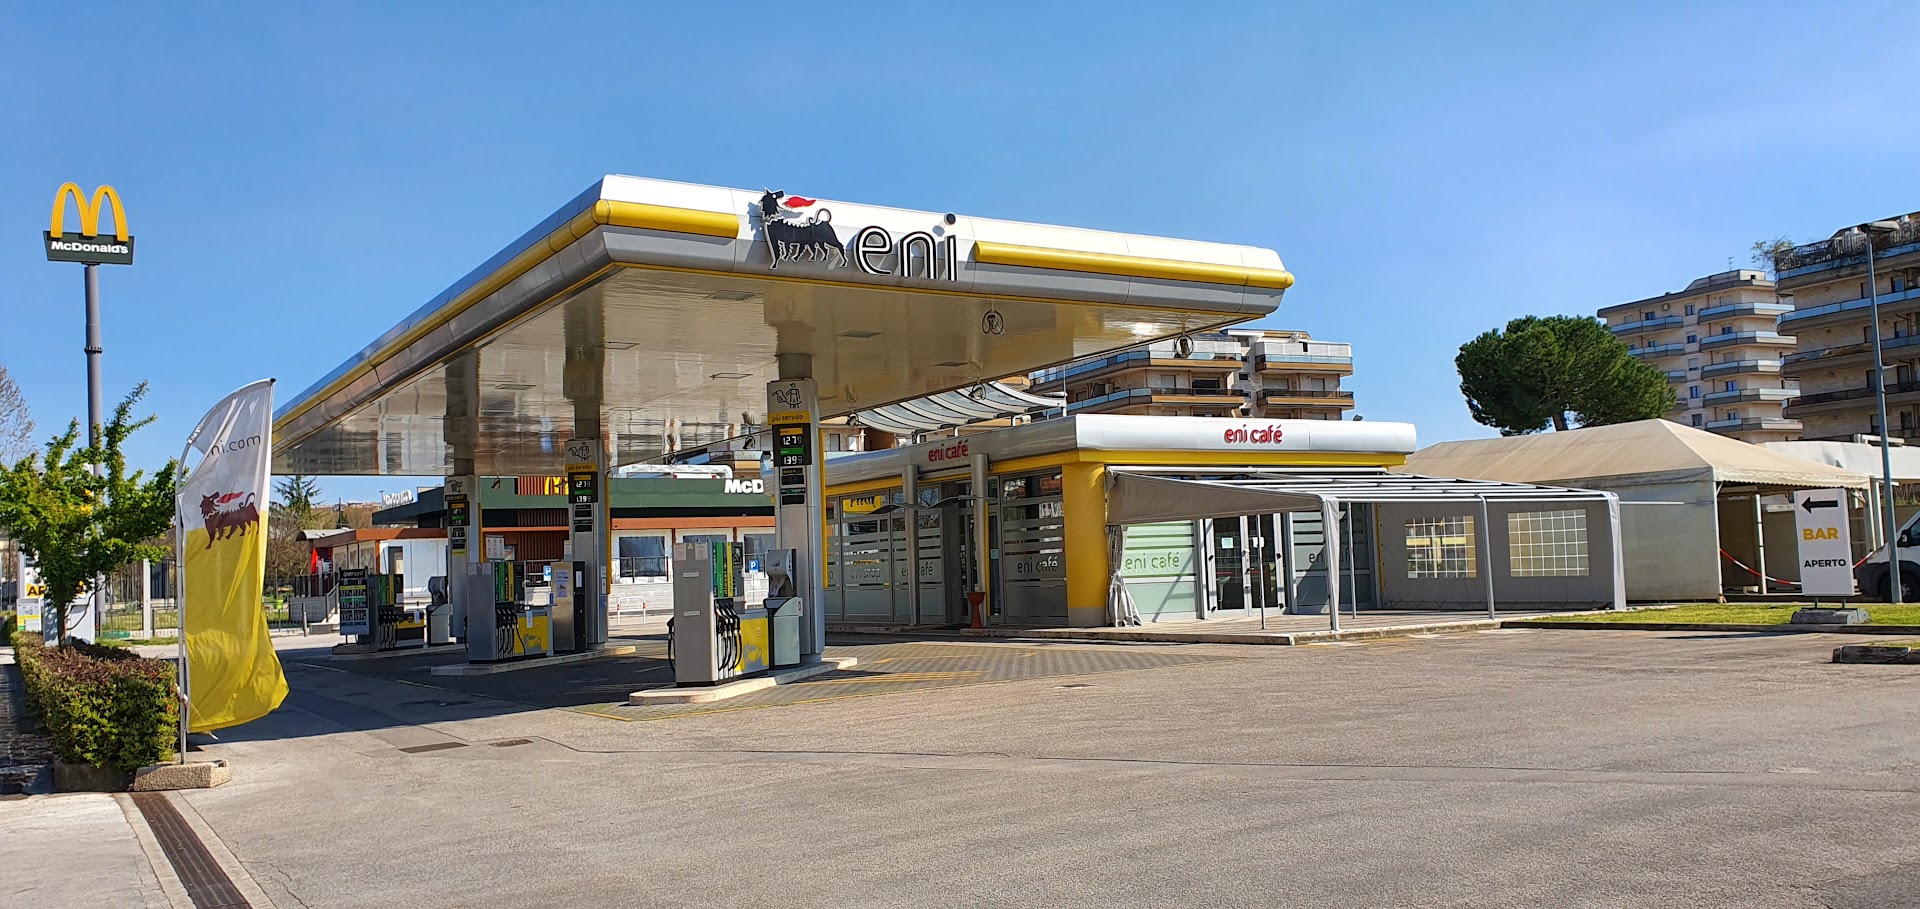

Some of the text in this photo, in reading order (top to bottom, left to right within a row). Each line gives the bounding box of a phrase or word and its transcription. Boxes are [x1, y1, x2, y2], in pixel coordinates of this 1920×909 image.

[51, 241, 129, 254] McDonald's
[854, 212, 958, 281] eni
[1224, 424, 1283, 444] eni café
[207, 435, 261, 457] ni.com
[928, 438, 969, 462] eni café
[1803, 527, 1838, 540] BAR
[919, 561, 933, 576] afé
[1017, 556, 1058, 573] eni café
[1125, 551, 1180, 570] eni café
[1804, 558, 1847, 568] APERTO
